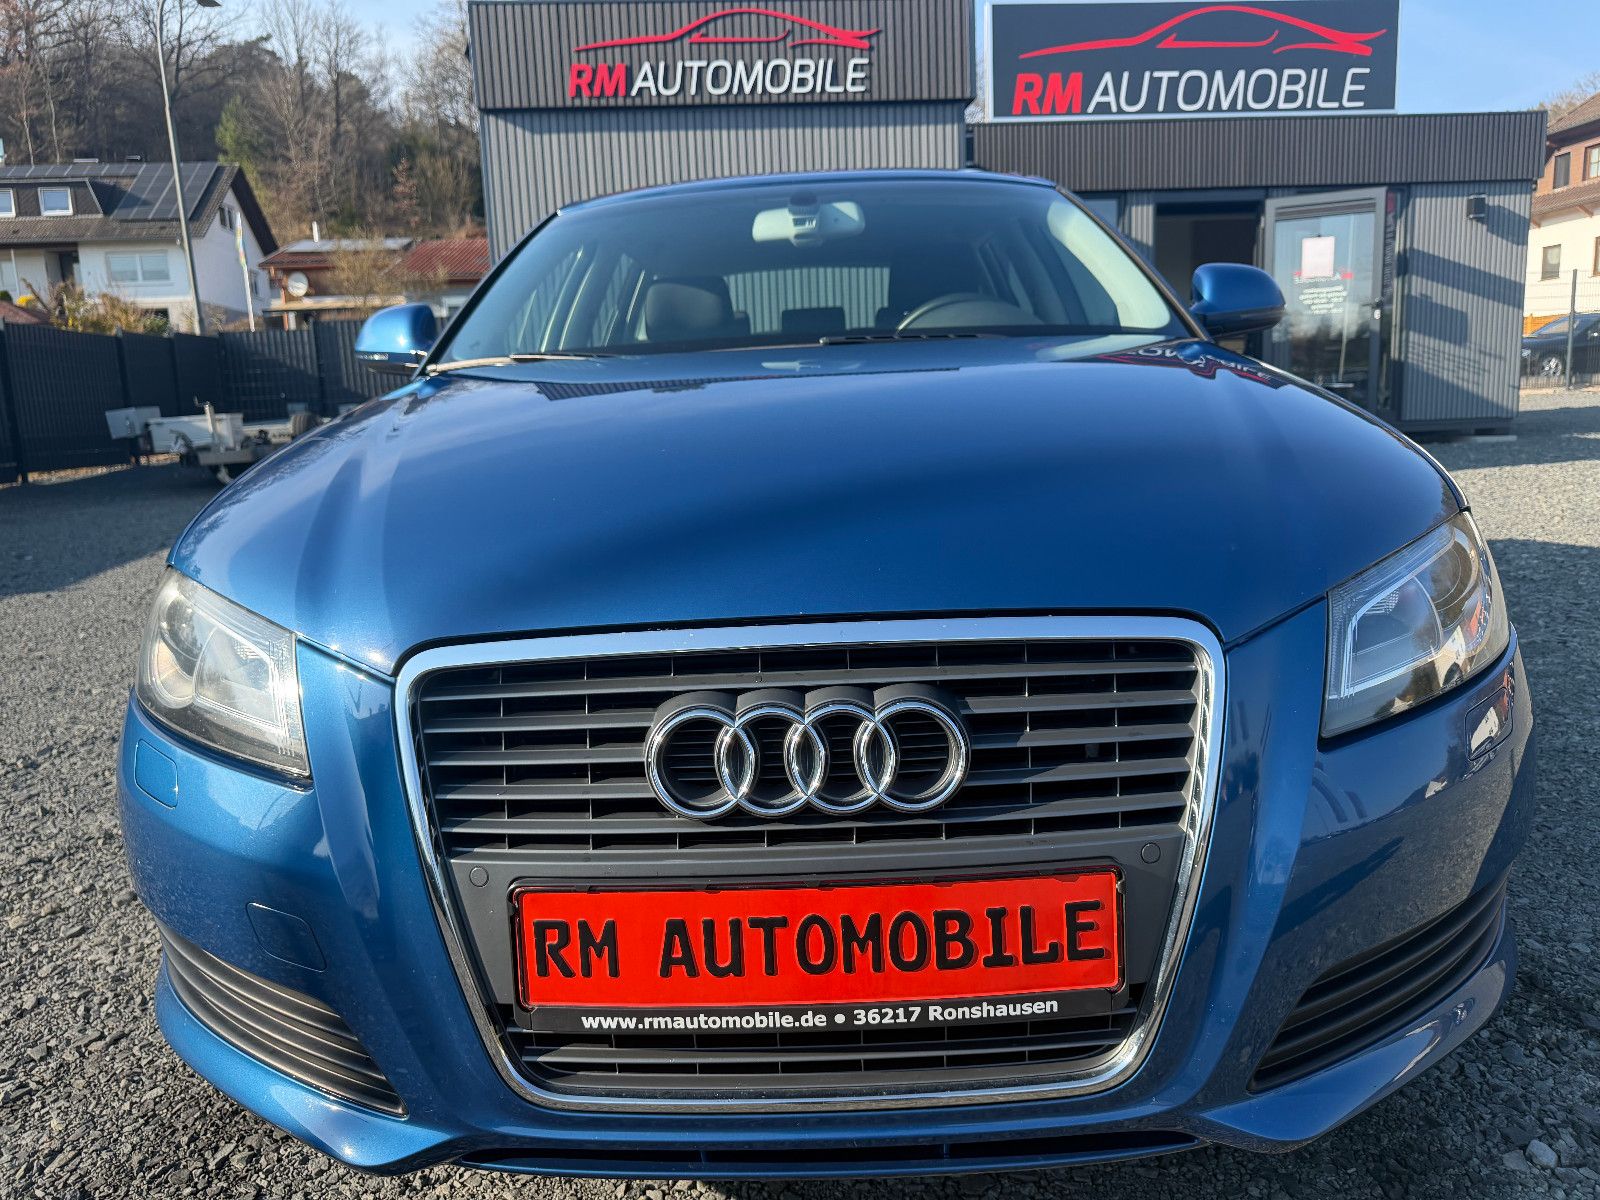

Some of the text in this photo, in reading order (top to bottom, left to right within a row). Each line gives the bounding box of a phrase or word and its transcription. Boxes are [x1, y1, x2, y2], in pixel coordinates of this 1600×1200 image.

[569, 57, 869, 98] RM AUTOMOBILE
[1012, 67, 1371, 115] RM AUTOMOBILE
[533, 900, 1107, 978] RM AUTOMOBILE
[581, 998, 1058, 1030] www.rmautomobile.de 36217 Ronshausen
